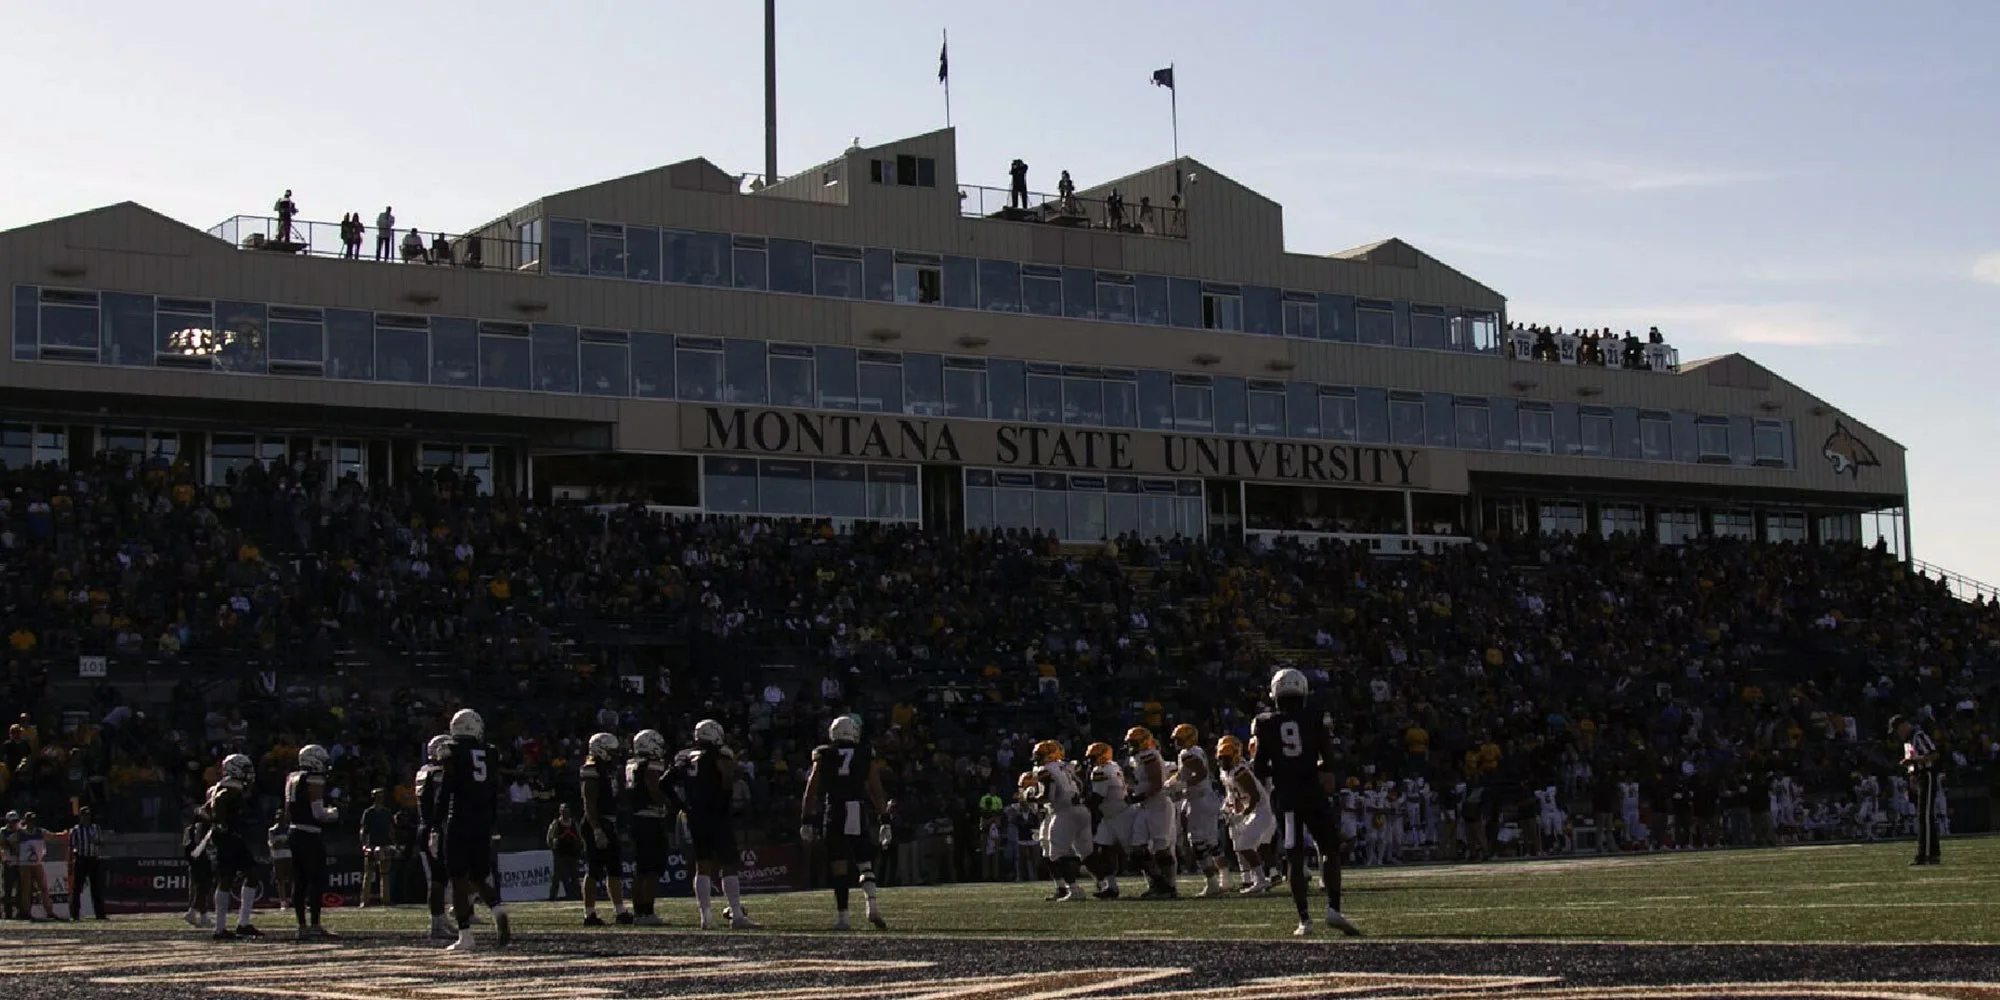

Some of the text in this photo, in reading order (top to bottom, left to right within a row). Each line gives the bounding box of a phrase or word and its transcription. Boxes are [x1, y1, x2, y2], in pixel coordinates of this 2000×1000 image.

[1517, 338, 1530, 356] 78
[704, 406, 1420, 486] MONTANA STATE UNIVERSITY
[83, 661, 105, 672] 101
[1279, 720, 1303, 758] 9
[470, 748, 488, 782] 5
[837, 747, 855, 777] 7
